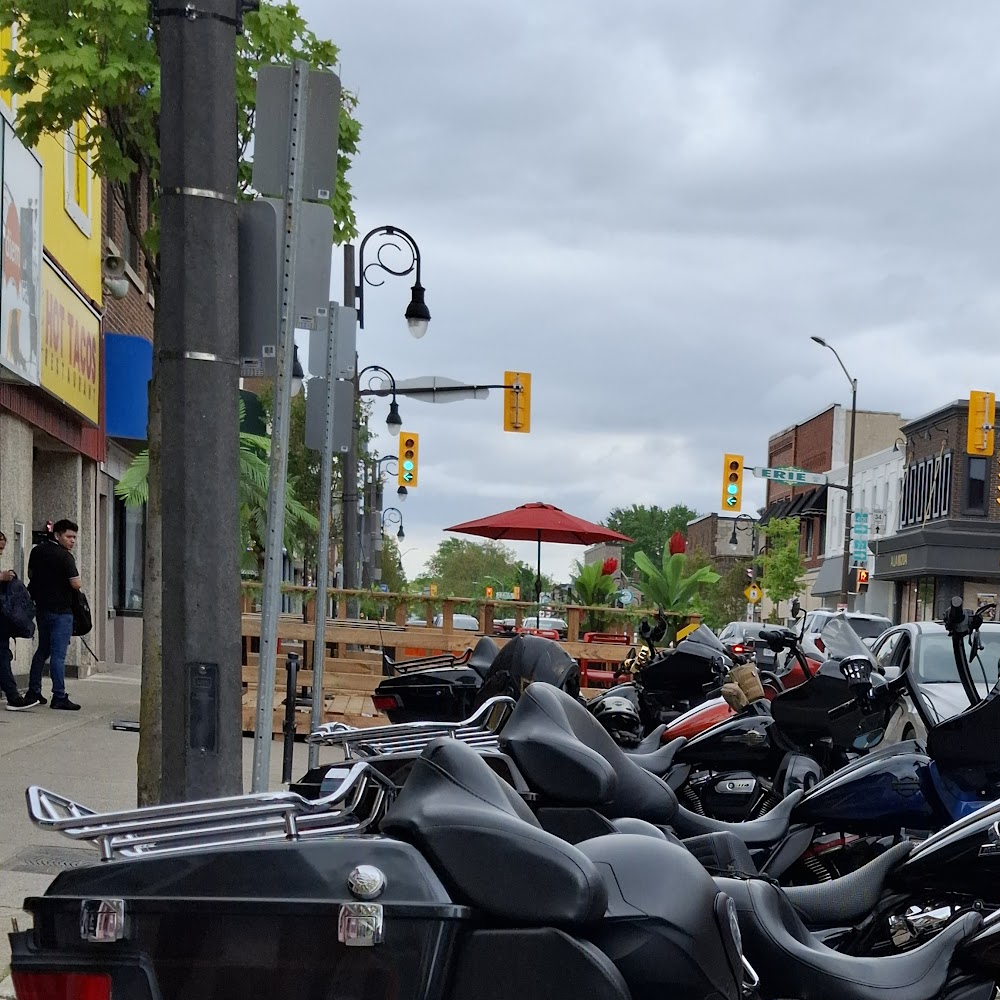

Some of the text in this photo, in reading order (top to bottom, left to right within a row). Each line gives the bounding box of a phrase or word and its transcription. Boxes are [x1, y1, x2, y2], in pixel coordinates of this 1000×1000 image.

[46, 290, 96, 385] HOT TACOS
[762, 469, 806, 481] ERIE
